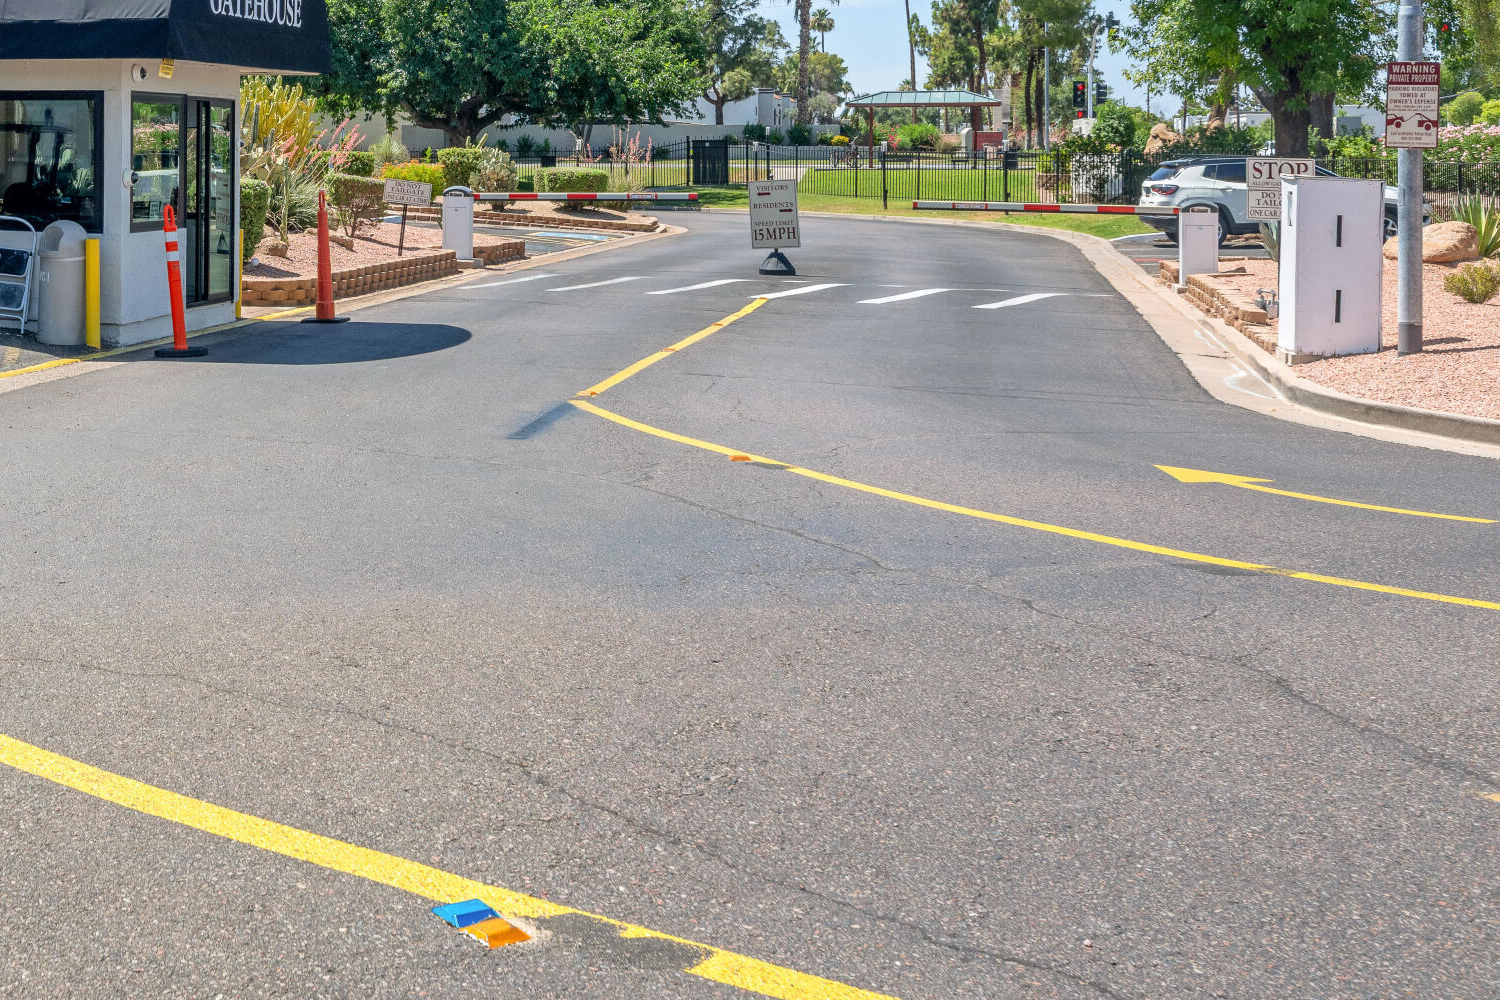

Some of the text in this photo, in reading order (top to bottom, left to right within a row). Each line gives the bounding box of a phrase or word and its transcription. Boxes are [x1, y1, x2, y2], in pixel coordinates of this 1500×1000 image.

[1392, 64, 1436, 73] WARNING
[1389, 74, 1438, 83] PRIVATE PROPERTY
[1252, 161, 1309, 180] STOP
[390, 187, 425, 195] TAILGATE
[754, 227, 796, 241] 15 MPH
